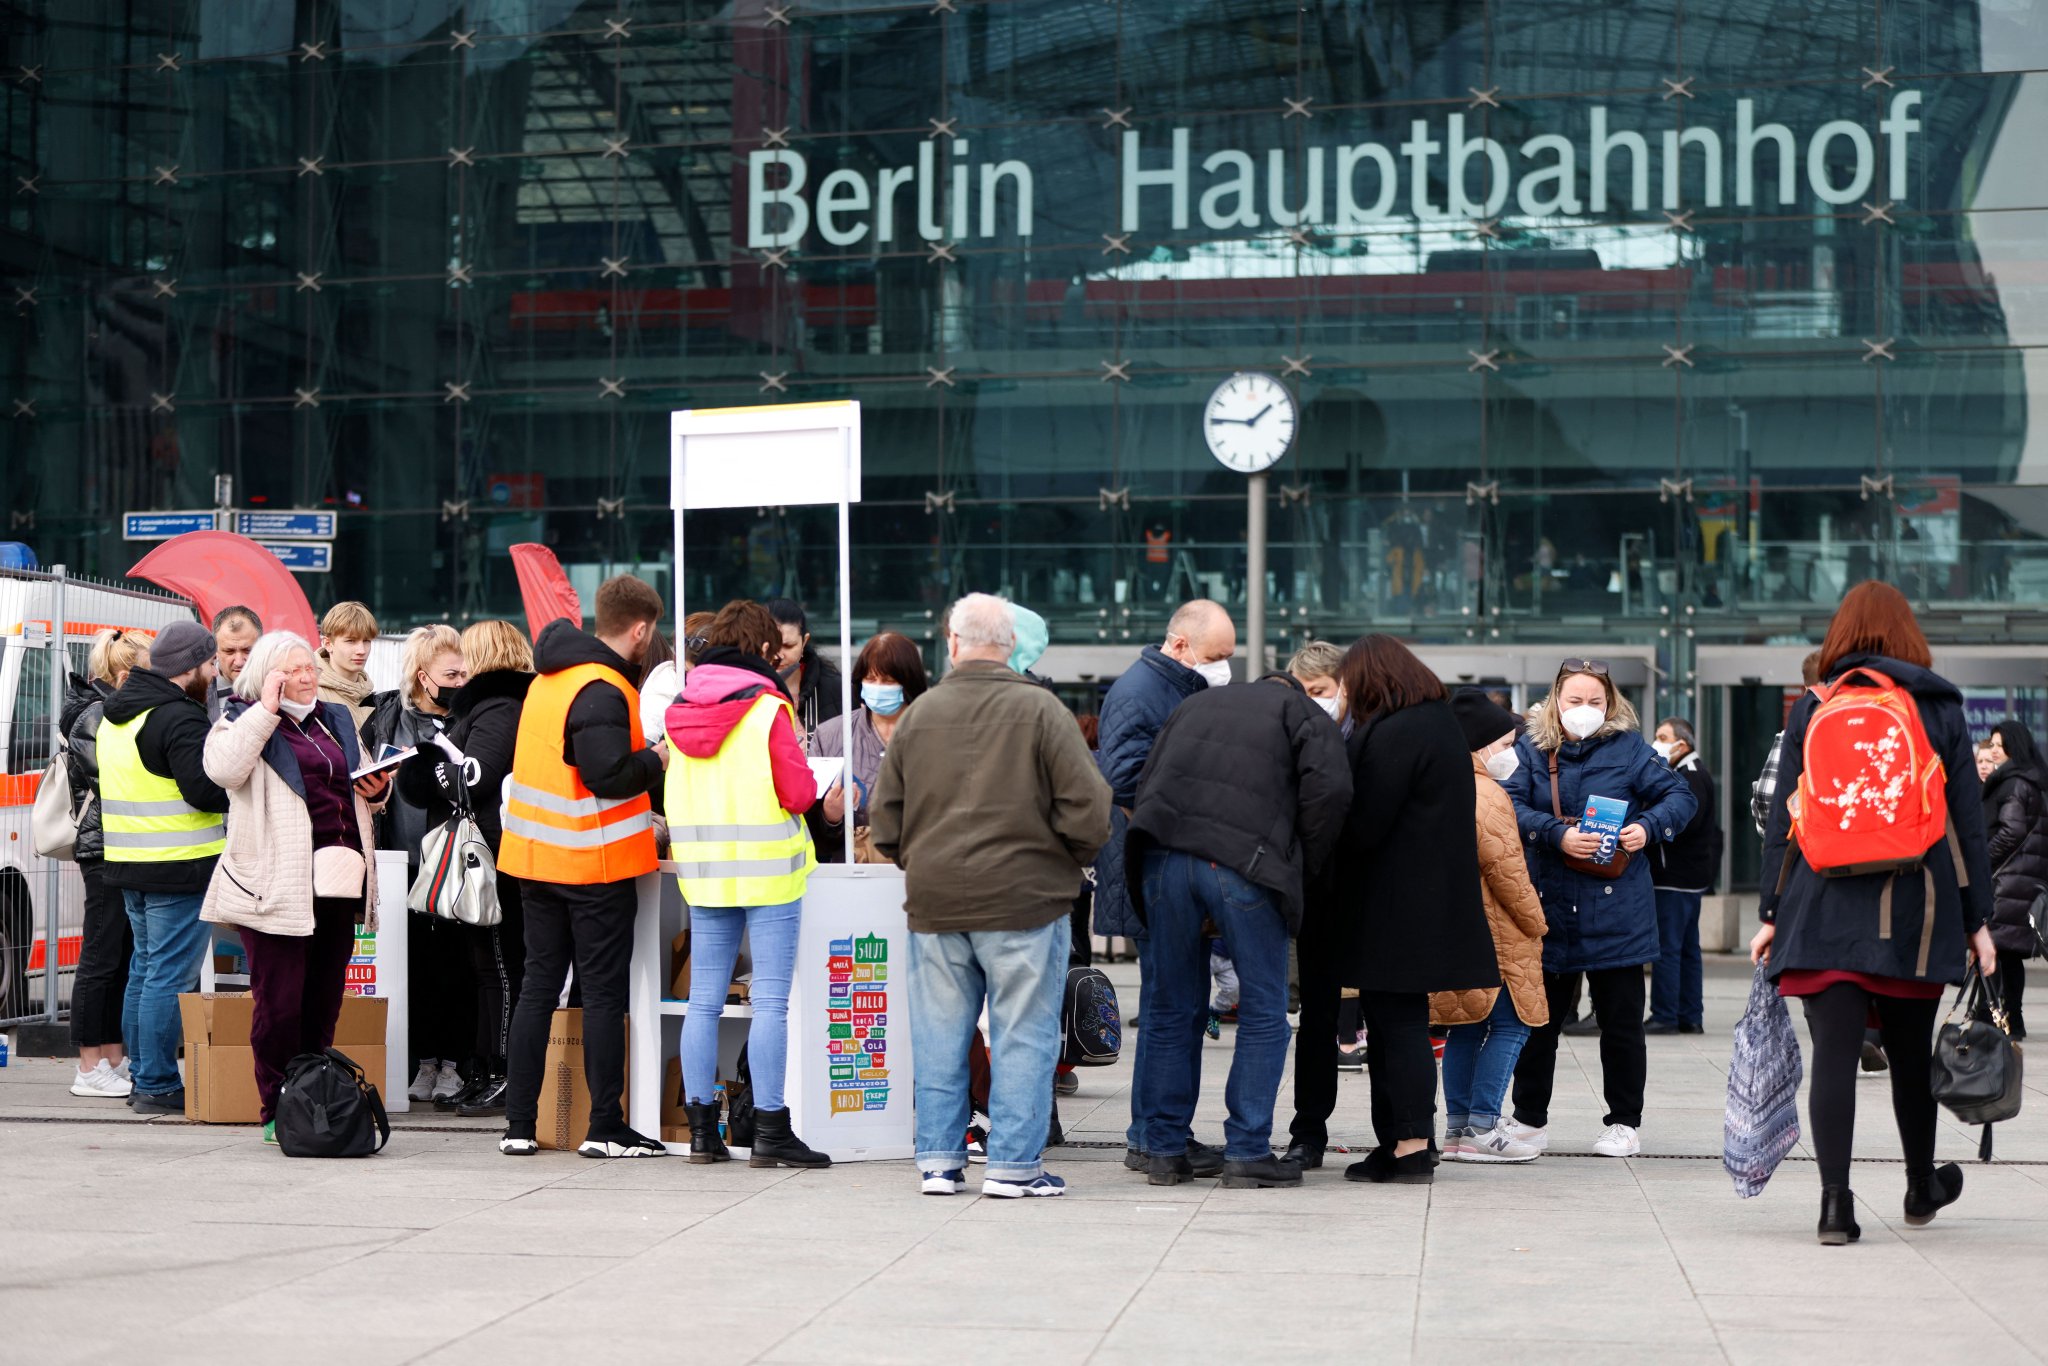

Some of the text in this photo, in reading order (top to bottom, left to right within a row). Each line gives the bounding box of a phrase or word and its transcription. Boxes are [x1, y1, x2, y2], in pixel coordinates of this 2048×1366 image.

[748, 89, 1922, 248] Berlin Hauptbahnhof
[1584, 820, 1618, 832] Allnet Flat
[858, 942, 884, 959] SALUT
[348, 968, 372, 979] ALLO
[856, 996, 883, 1009] HALLO
[856, 1017, 872, 1025] HOLA
[837, 1094, 860, 1108] AHOJ
[1490, 1136, 1510, 1151] N
